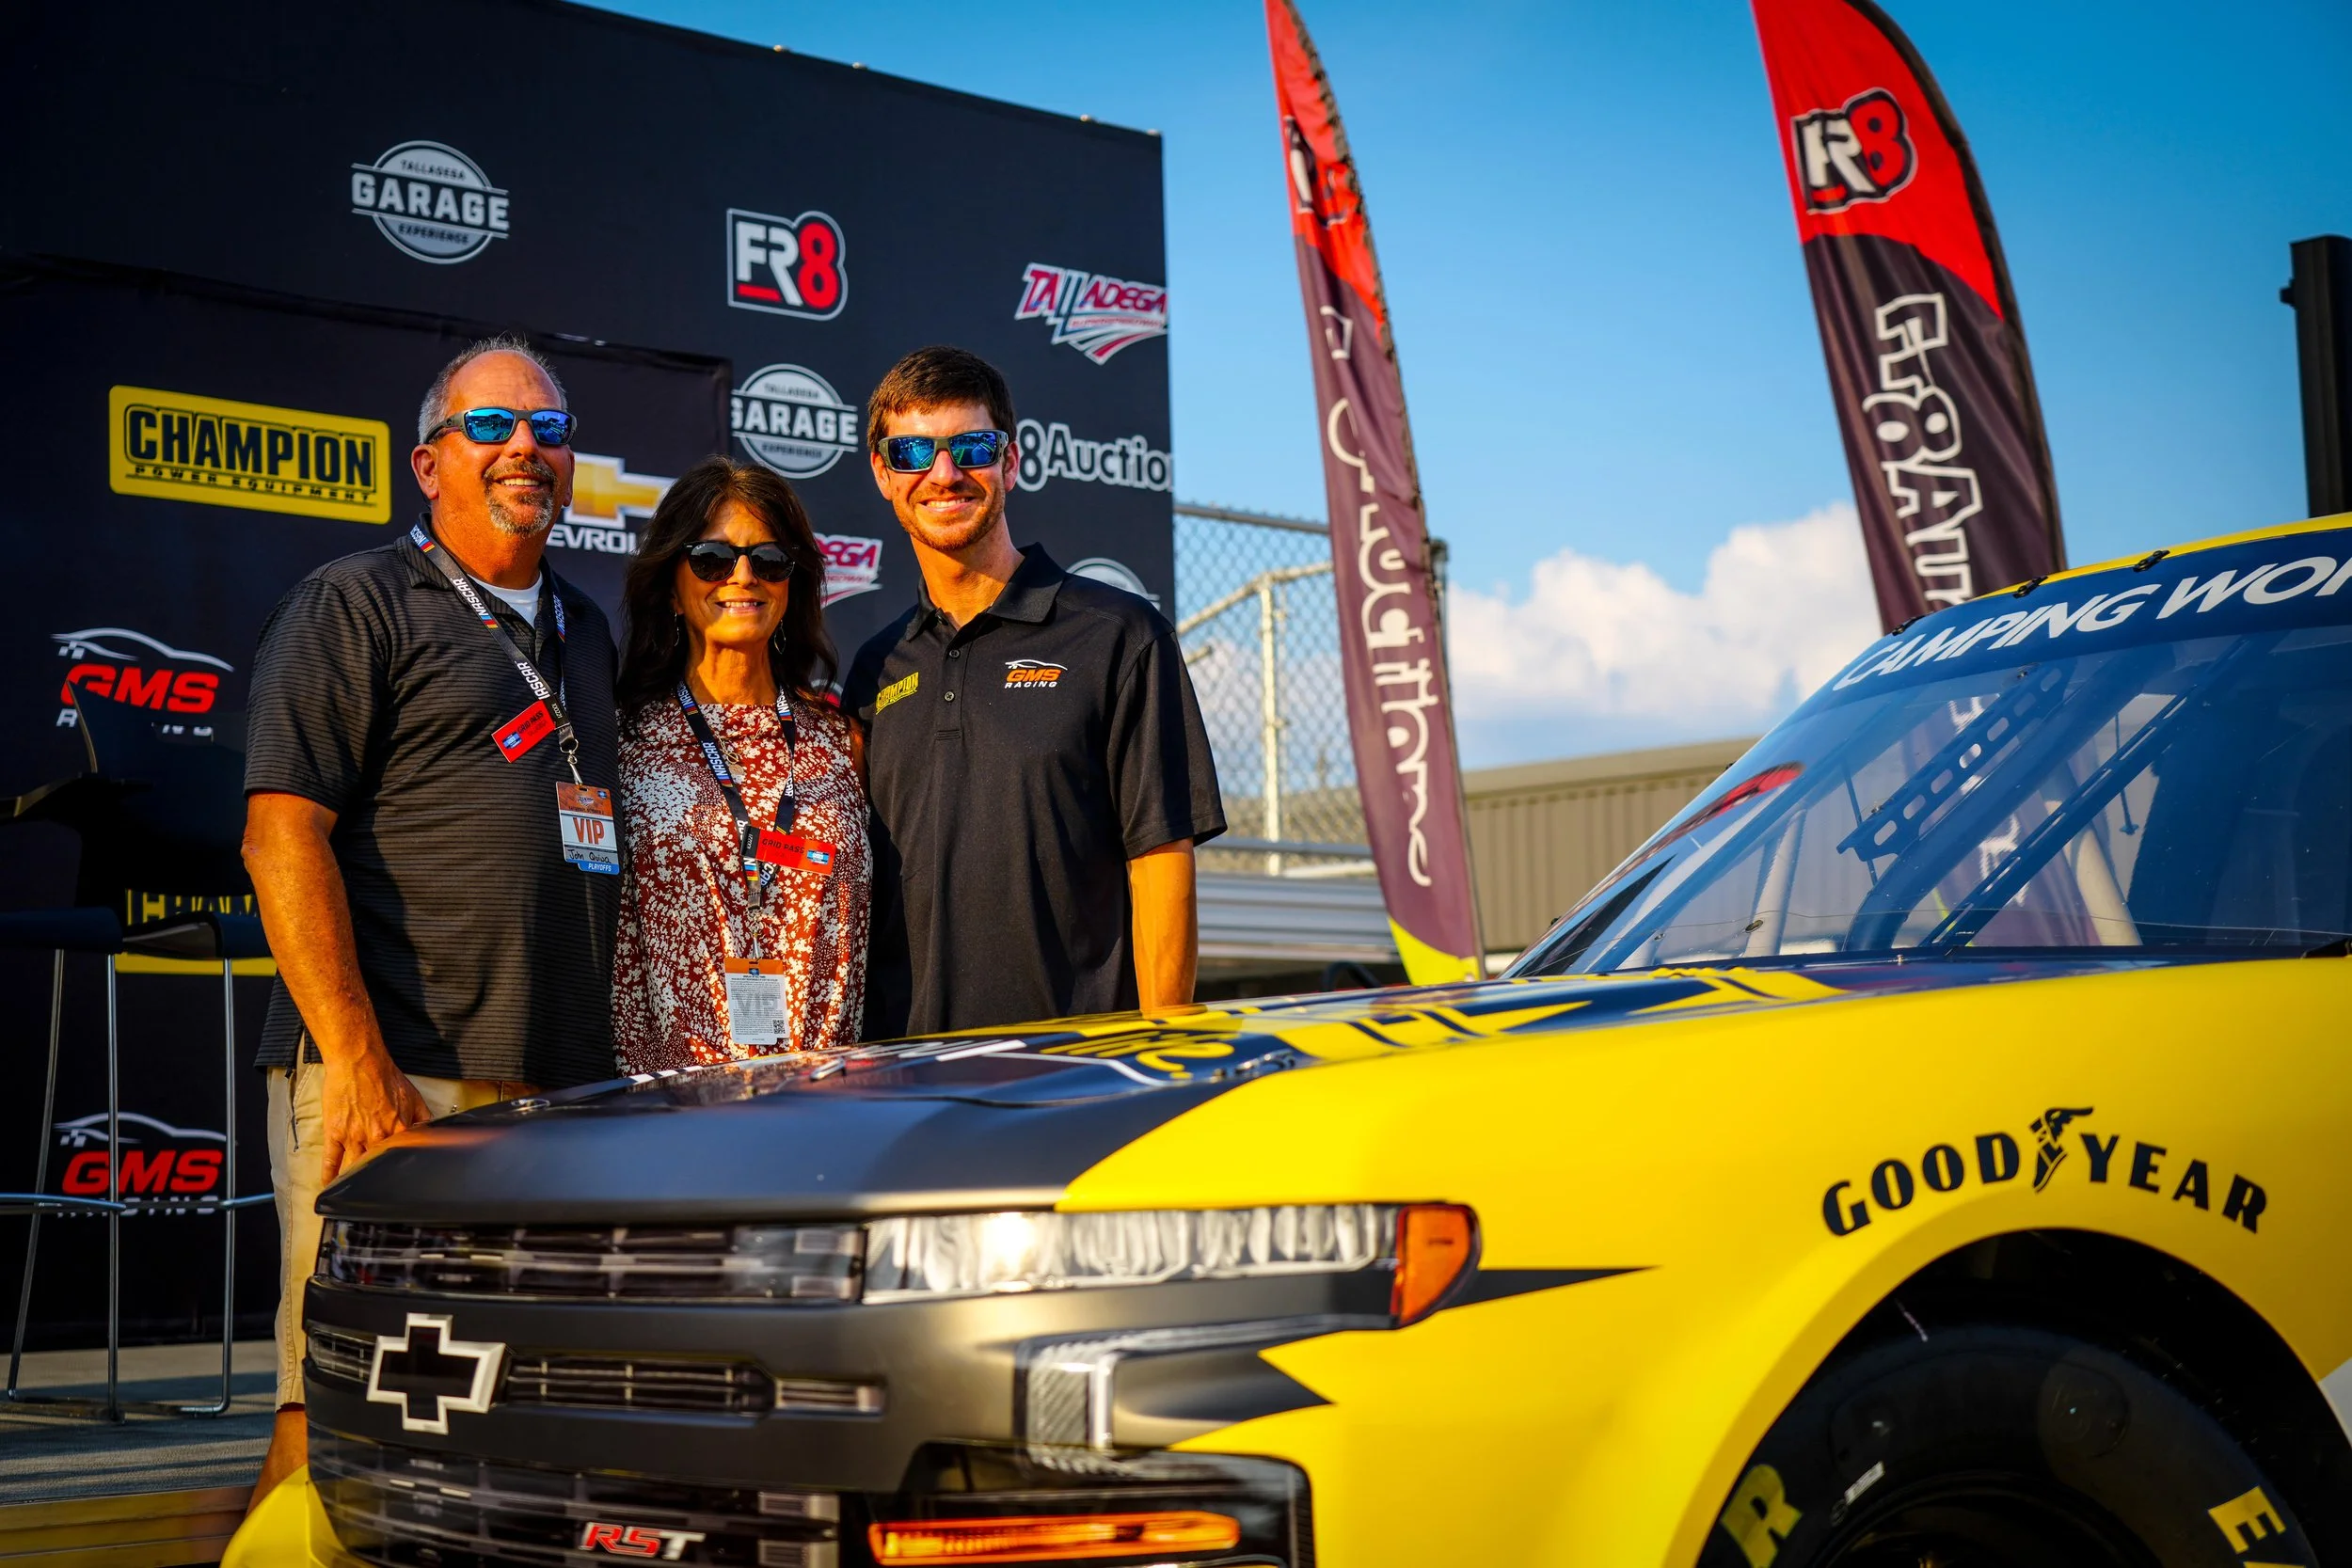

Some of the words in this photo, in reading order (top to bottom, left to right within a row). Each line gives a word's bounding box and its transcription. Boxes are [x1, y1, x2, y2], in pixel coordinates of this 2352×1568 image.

[351, 171, 510, 231] GARAGE
[736, 220, 839, 309] FR8
[128, 408, 373, 489] CHAMPION
[1018, 420, 1173, 492] 8Auctio
[135, 465, 217, 483] POWER
[231, 476, 372, 503] EQUIPMENT
[453, 577, 489, 617] NASCAR
[1833, 583, 2162, 691] CAMPING
[60, 663, 219, 714] GMS
[876, 673, 919, 708] CHAMPION
[1005, 680, 1058, 689] RACING
[1006, 669, 1062, 682] GMS
[702, 741, 729, 776] NASCAR
[573, 816, 605, 845] VIP
[762, 838, 783, 848] GRID
[784, 845, 804, 854] PASS
[567, 848, 585, 860] John
[588, 863, 612, 872] PLAYOFFS
[62, 1150, 223, 1195] GMS
[578, 1521, 707, 1560] RST
